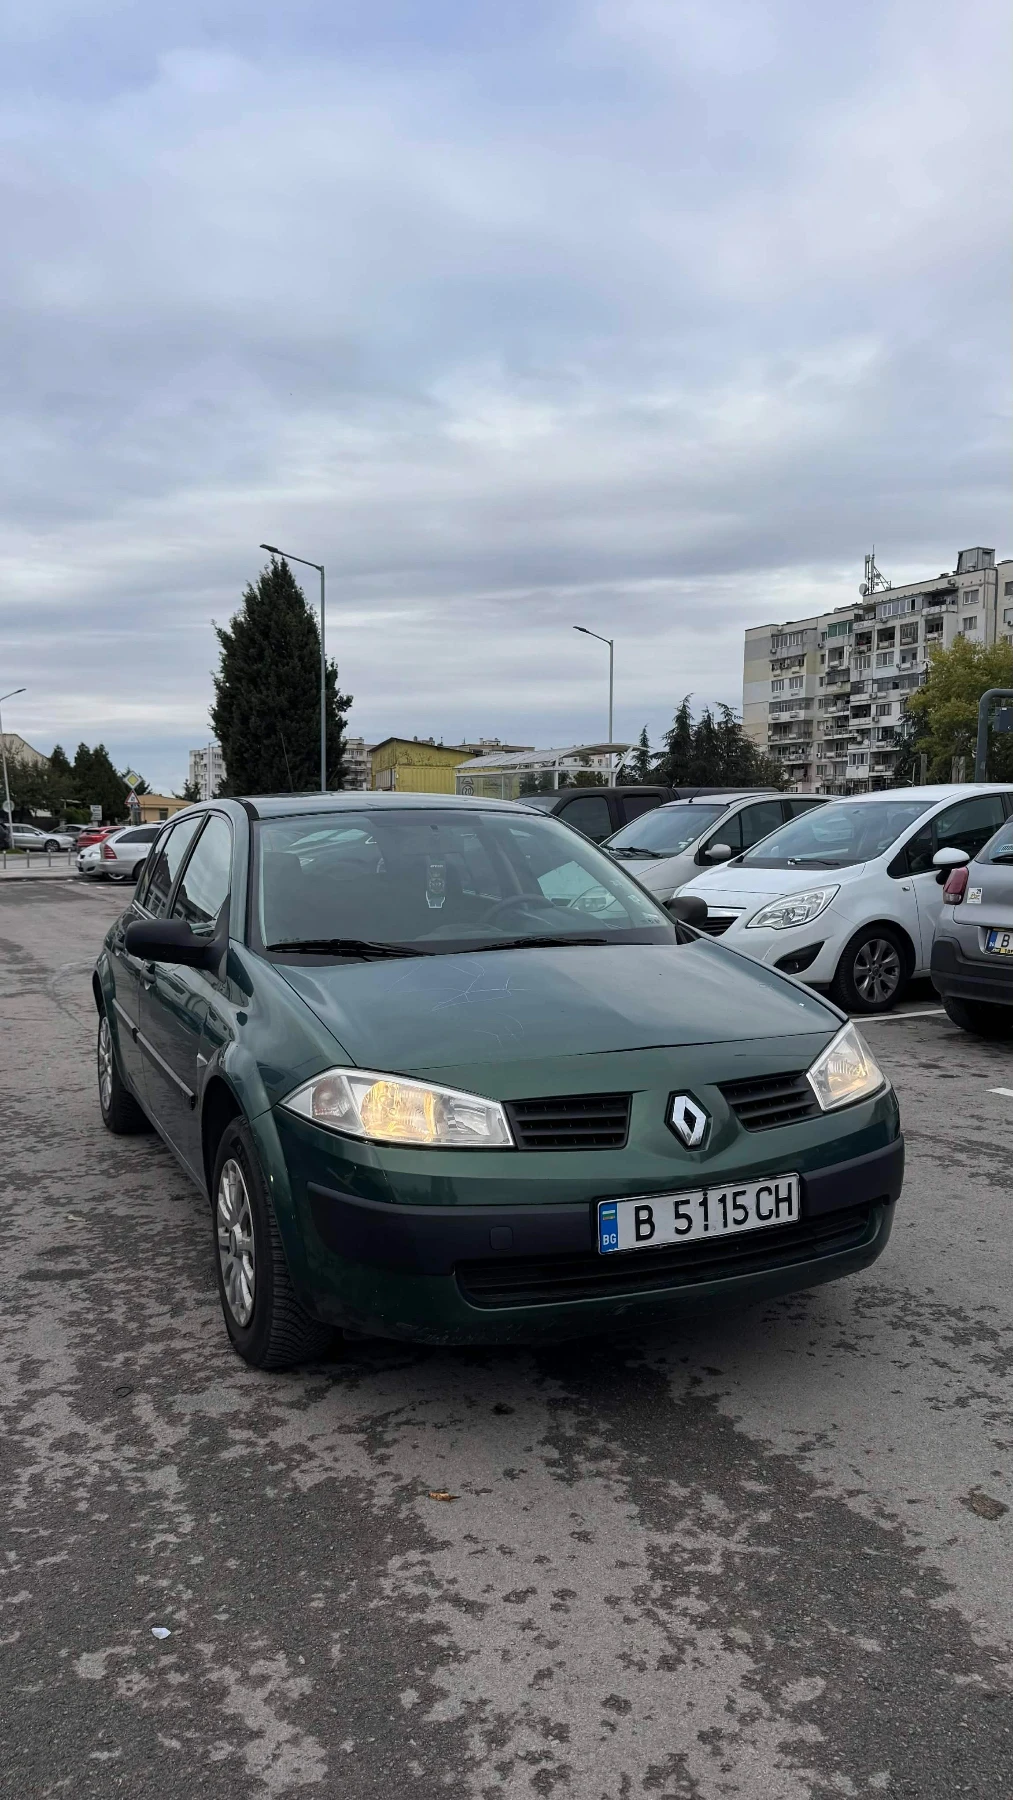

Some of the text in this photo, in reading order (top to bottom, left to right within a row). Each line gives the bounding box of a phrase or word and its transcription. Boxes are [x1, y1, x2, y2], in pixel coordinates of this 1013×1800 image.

[1001, 933, 1011, 948] B
[634, 1204, 656, 1242] B
[602, 1234, 617, 1246] BG
